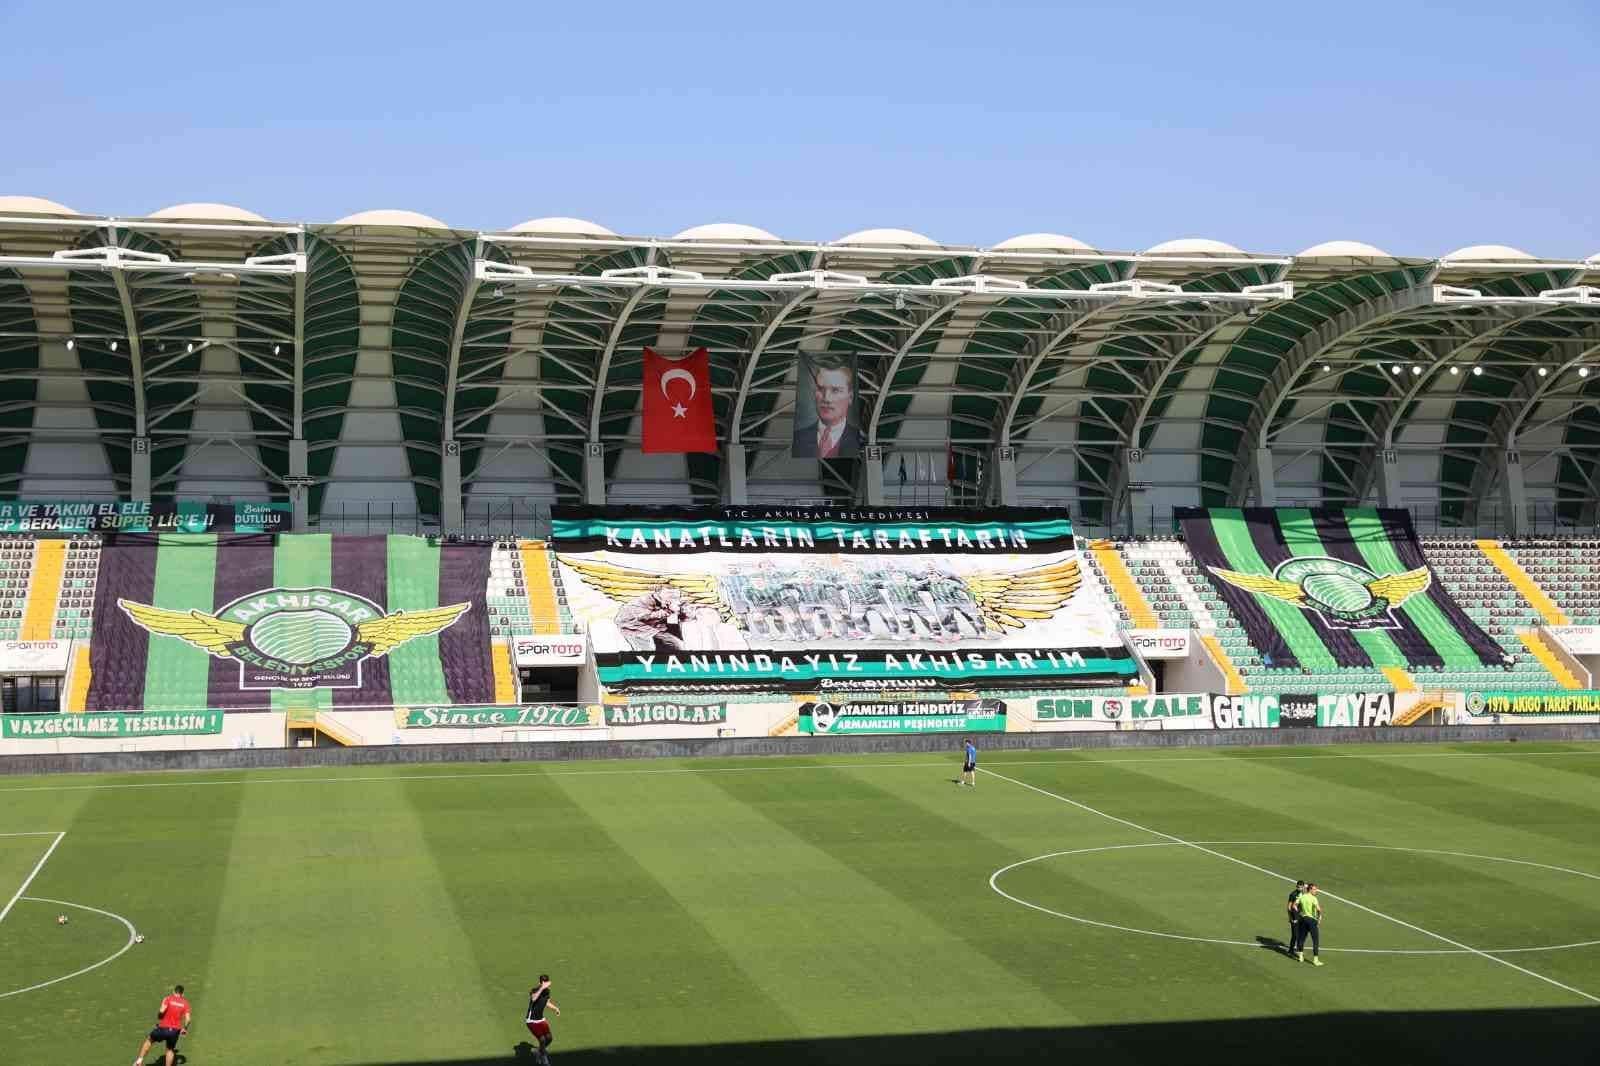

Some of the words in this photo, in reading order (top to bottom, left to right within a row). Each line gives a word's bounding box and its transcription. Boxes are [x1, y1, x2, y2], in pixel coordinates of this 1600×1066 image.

[19, 504, 39, 517] VE
[43, 503, 94, 516] TAKIM
[98, 503, 117, 515] EL
[122, 502, 151, 515] ELE
[20, 516, 96, 530] BERABER
[234, 514, 281, 524] DUTLULU
[606, 526, 815, 549] KANATLARIN
[832, 528, 1029, 549] TARAFTARIN
[636, 653, 863, 673] YANINDAYIZ
[884, 650, 1087, 671] AKHİSAR'IM
[416, 707, 505, 727] Since
[517, 705, 580, 726] 1970
[839, 704, 899, 716] ATAMIZIN
[1036, 698, 1093, 719] SON
[1131, 696, 1203, 719] KALE
[1318, 693, 1394, 727] TAYFA
[837, 718, 900, 729] ARMAMIZIN
